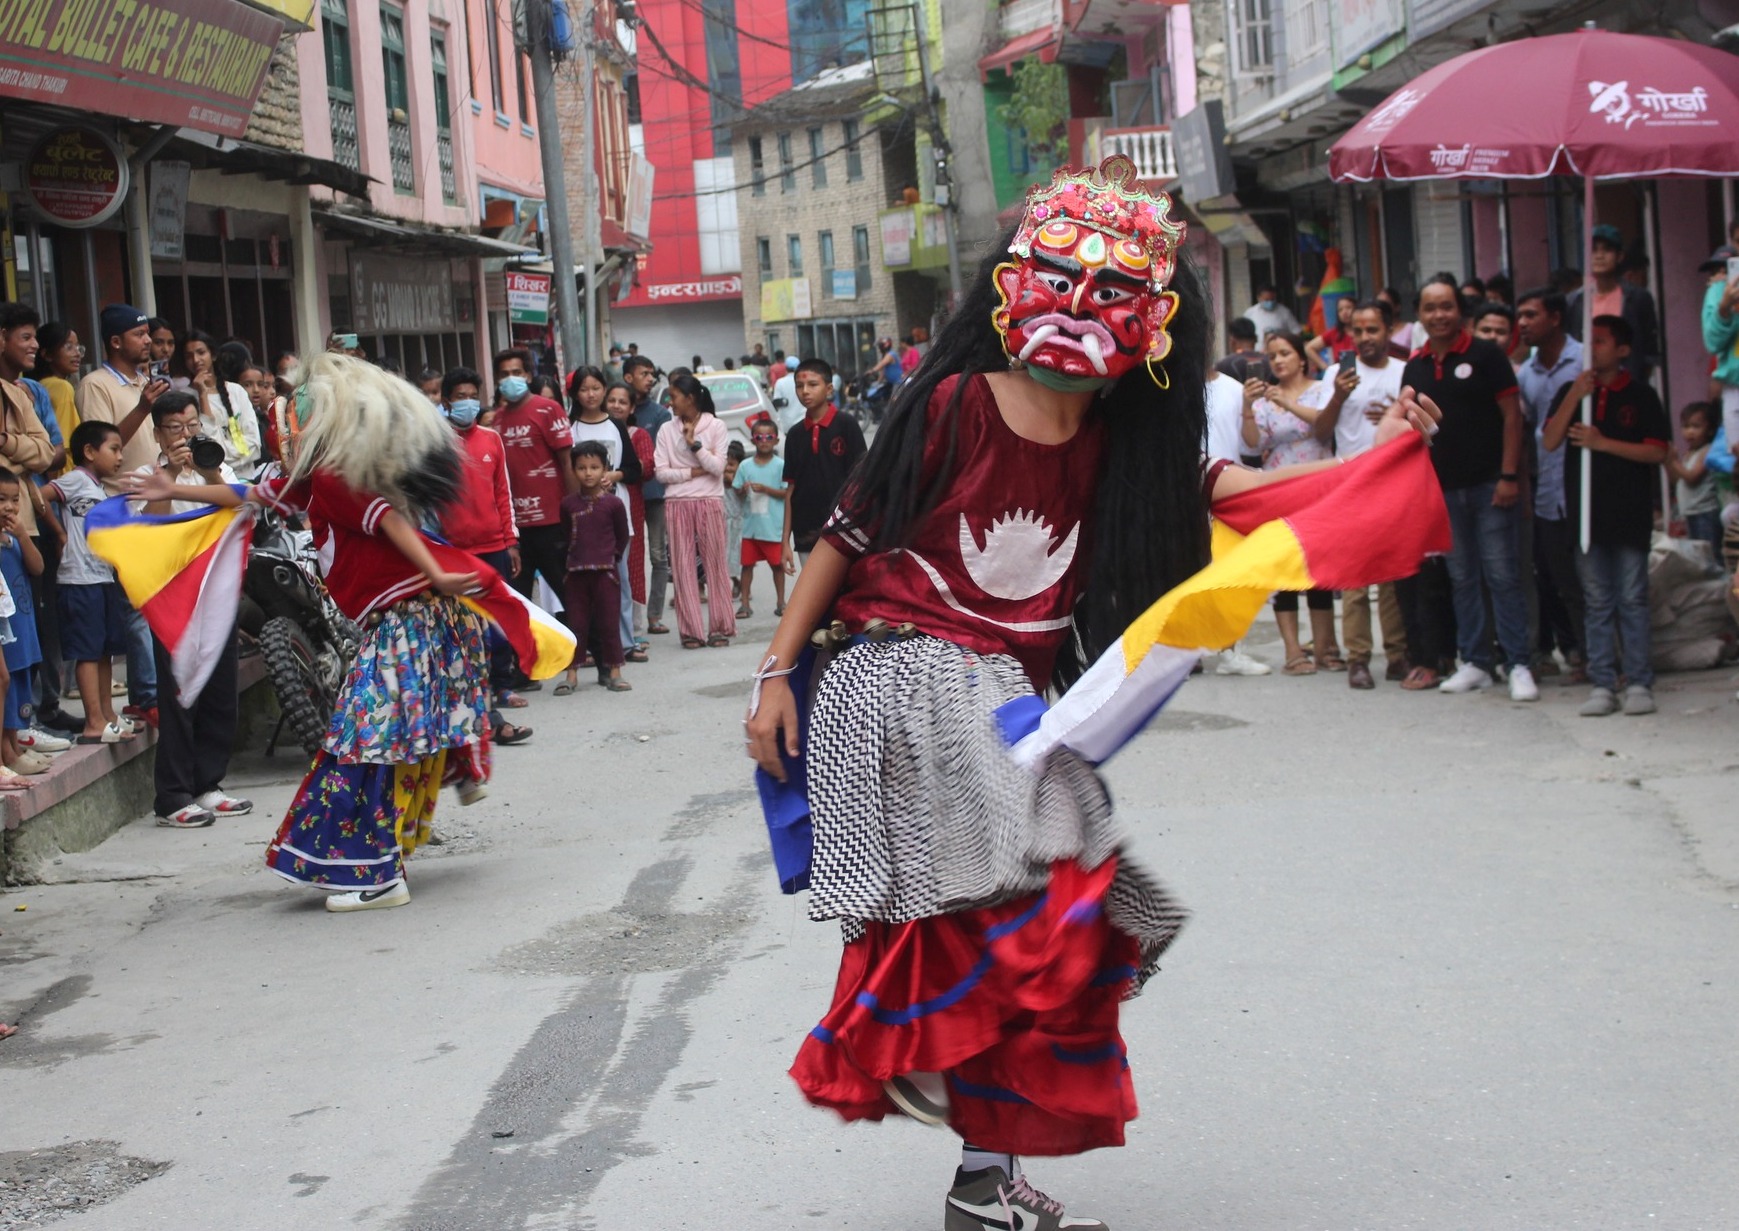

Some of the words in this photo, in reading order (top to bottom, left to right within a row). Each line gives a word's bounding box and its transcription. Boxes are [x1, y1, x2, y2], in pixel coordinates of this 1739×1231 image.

[47, 0, 138, 64] BULLET
[121, 3, 179, 75] CAFE
[163, 16, 190, 79] &
[175, 21, 272, 100] RESTAURANT
